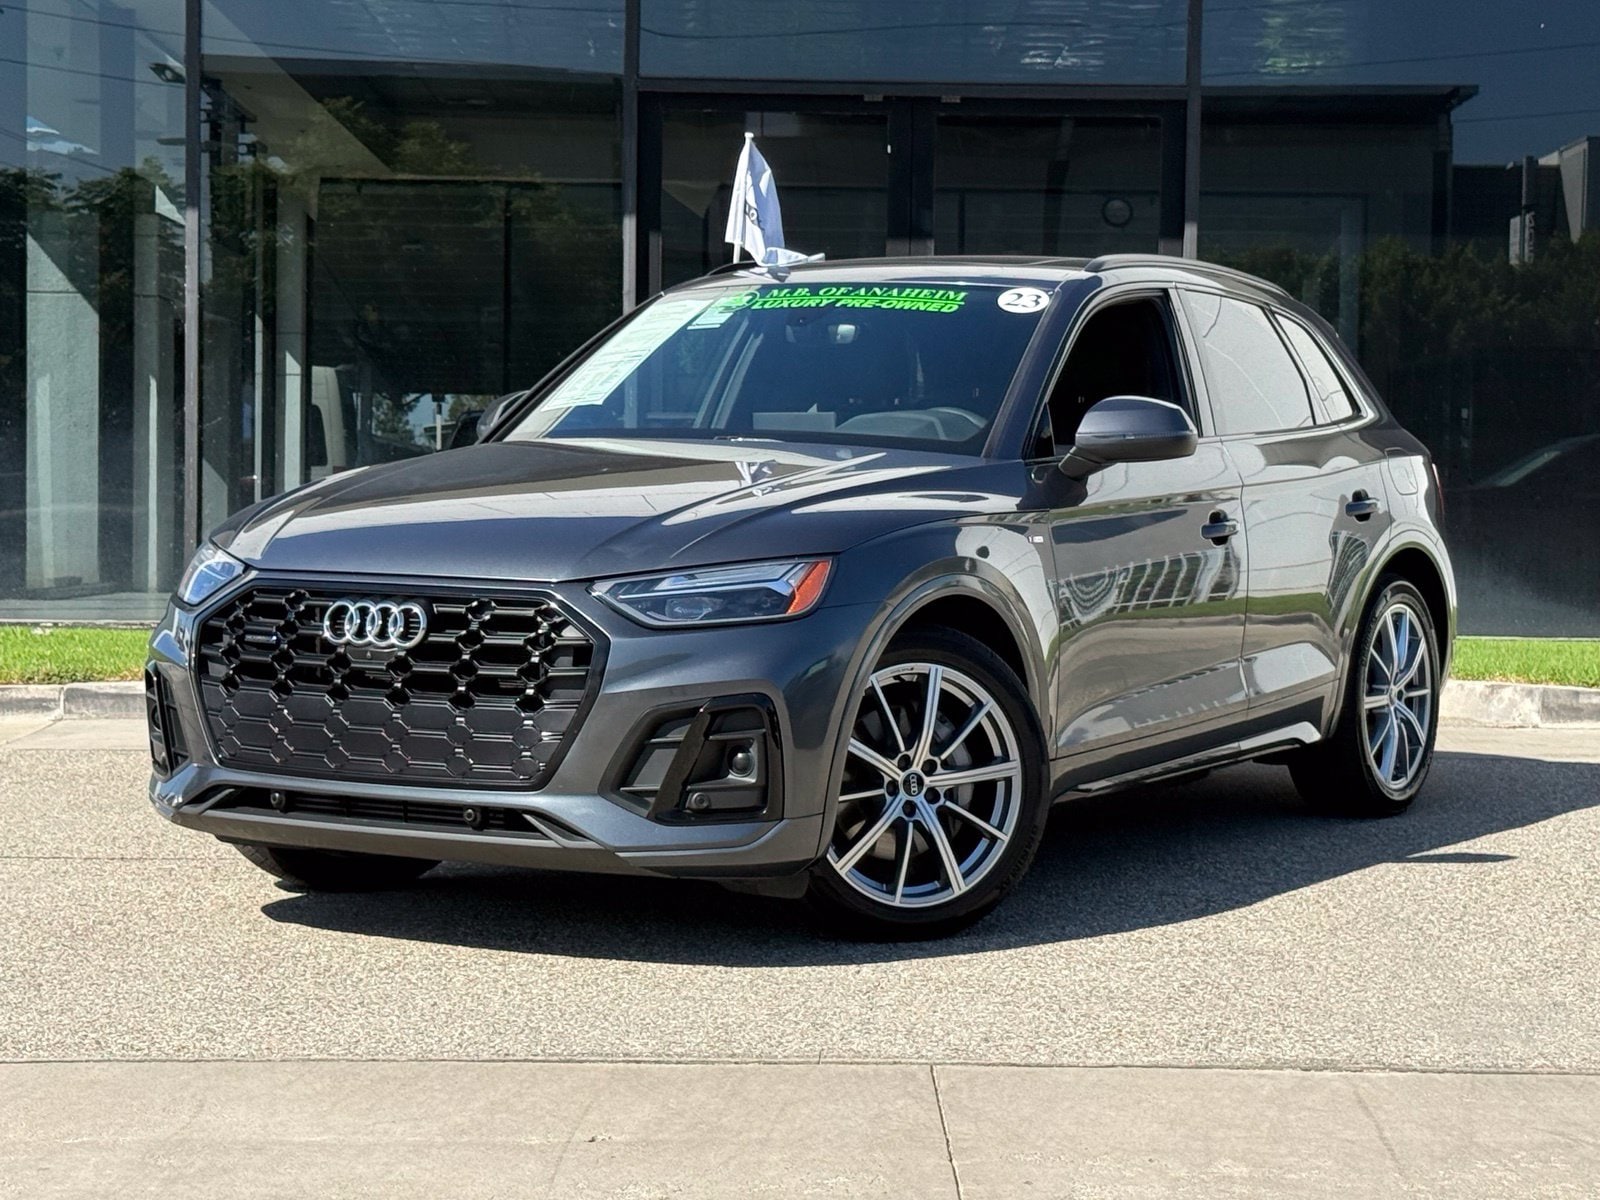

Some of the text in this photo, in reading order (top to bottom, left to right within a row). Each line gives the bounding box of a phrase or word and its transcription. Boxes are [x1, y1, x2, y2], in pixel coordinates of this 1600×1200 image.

[765, 286, 968, 301] M.B. OF ANAHEIM
[1005, 292, 1043, 308] 23
[751, 298, 961, 313] LUXURY PRE-OWNED
